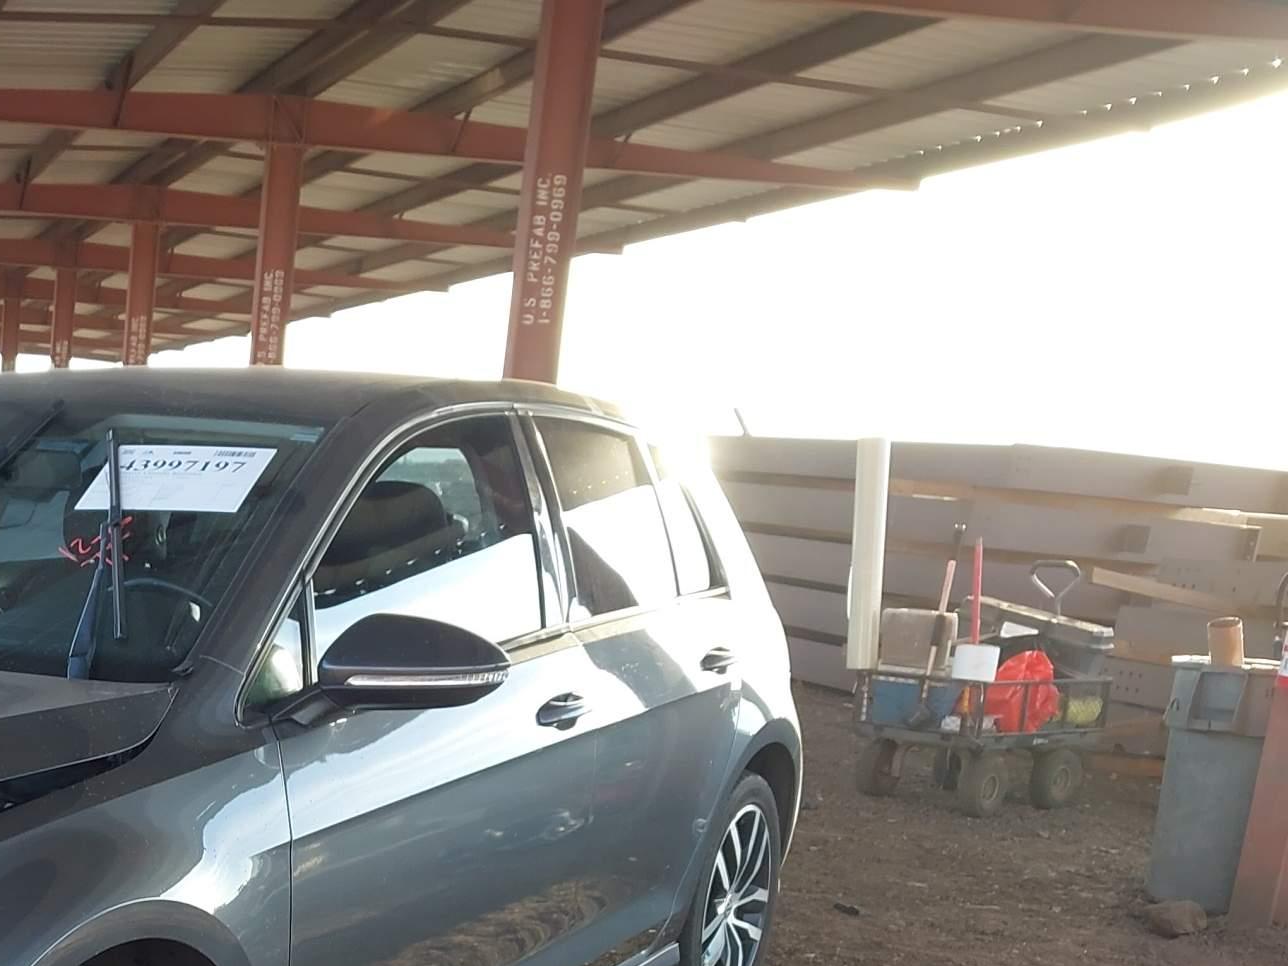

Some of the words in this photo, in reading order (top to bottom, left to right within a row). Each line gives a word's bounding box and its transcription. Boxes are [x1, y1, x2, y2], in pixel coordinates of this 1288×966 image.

[527, 214, 546, 282] PREFAB
[538, 174, 568, 323] 1-866-799-0969
[119, 459, 248, 473] 43997197
